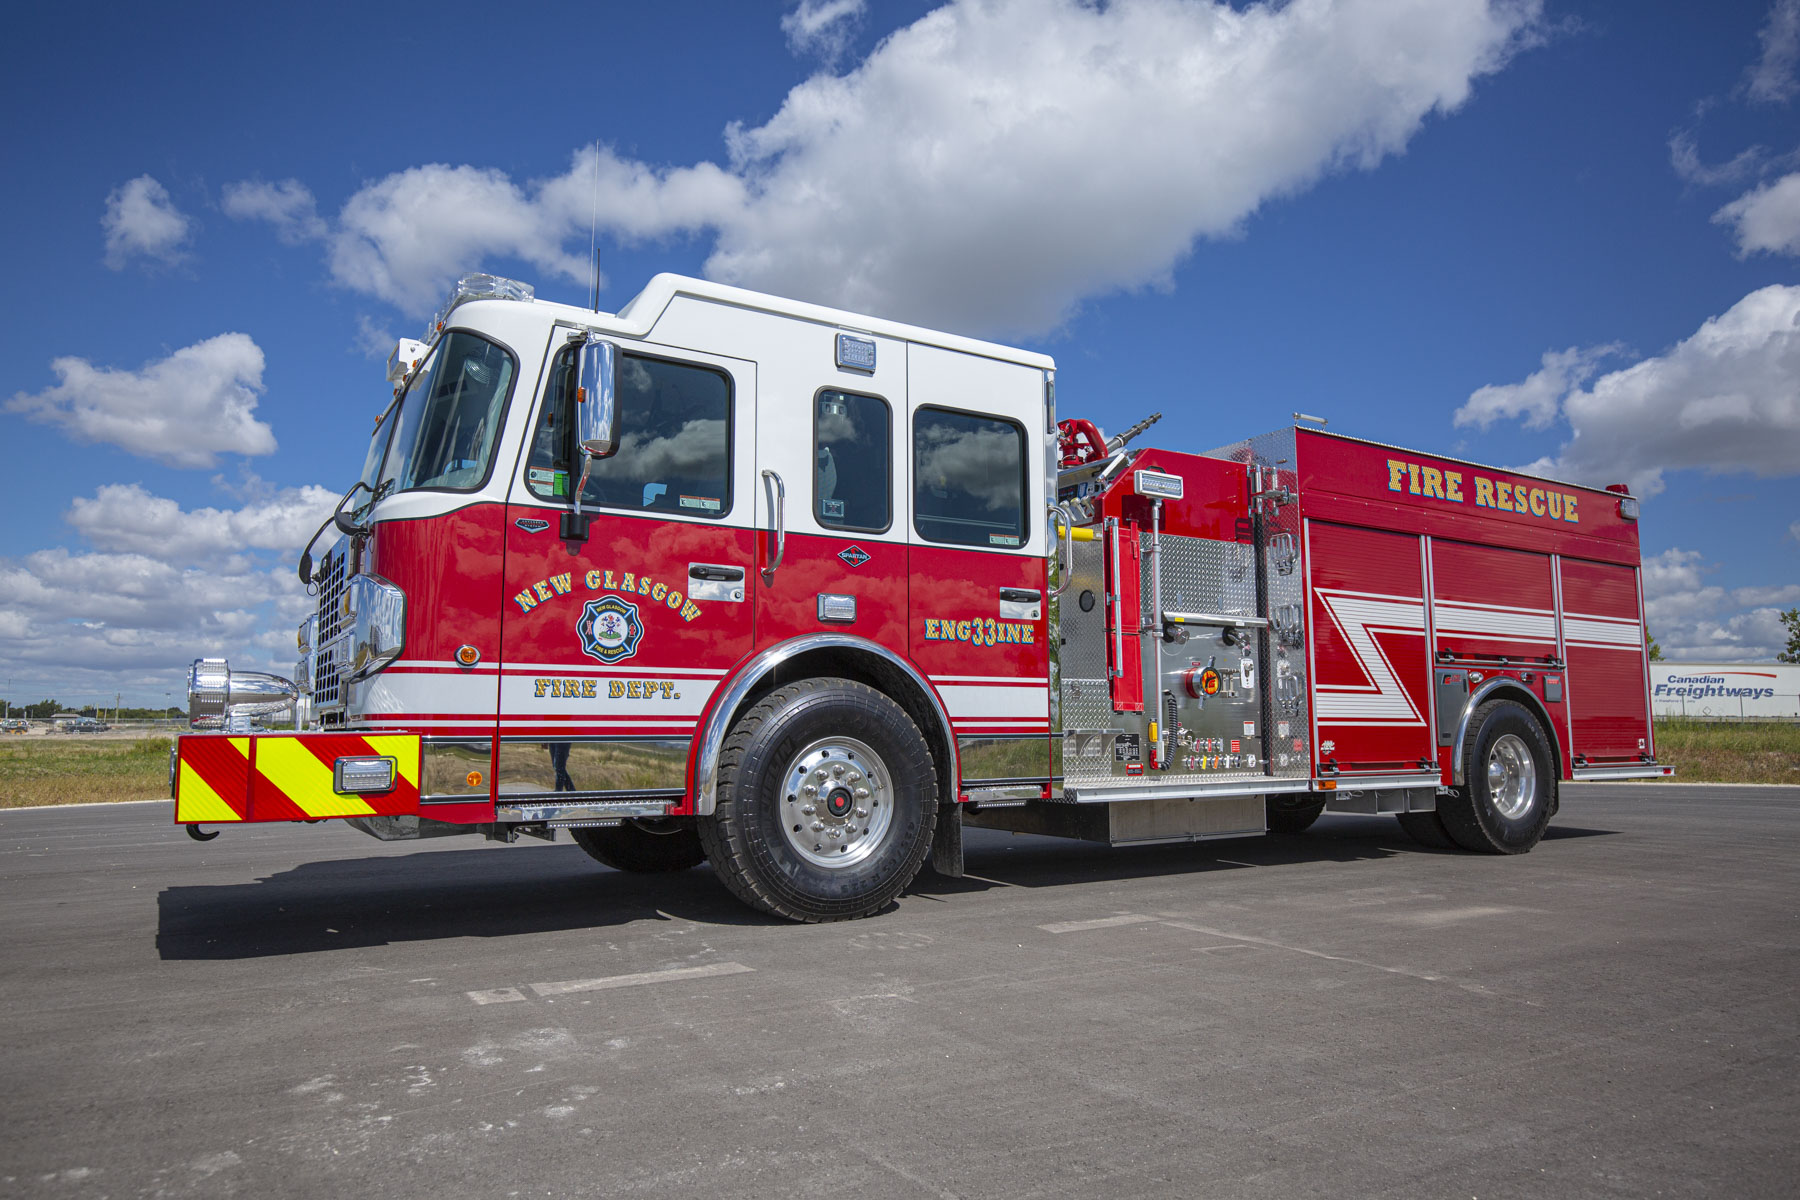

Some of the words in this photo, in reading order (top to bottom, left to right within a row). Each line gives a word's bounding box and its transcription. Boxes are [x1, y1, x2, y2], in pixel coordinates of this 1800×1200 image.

[1387, 459, 1463, 502] FIRE
[1474, 476, 1579, 523] RESCUE
[841, 552, 868, 560] SPARTAN
[514, 572, 572, 614] NEW
[585, 570, 702, 623] GLASGOW
[606, 603, 627, 614] GLASGOW
[594, 644, 604, 653] FIRE
[608, 646, 625, 655] RESCUE
[1667, 675, 1725, 684] Canadian
[534, 678, 597, 698] FIRE
[609, 679, 681, 699] DEPT.
[1654, 684, 1774, 699] Freightways
